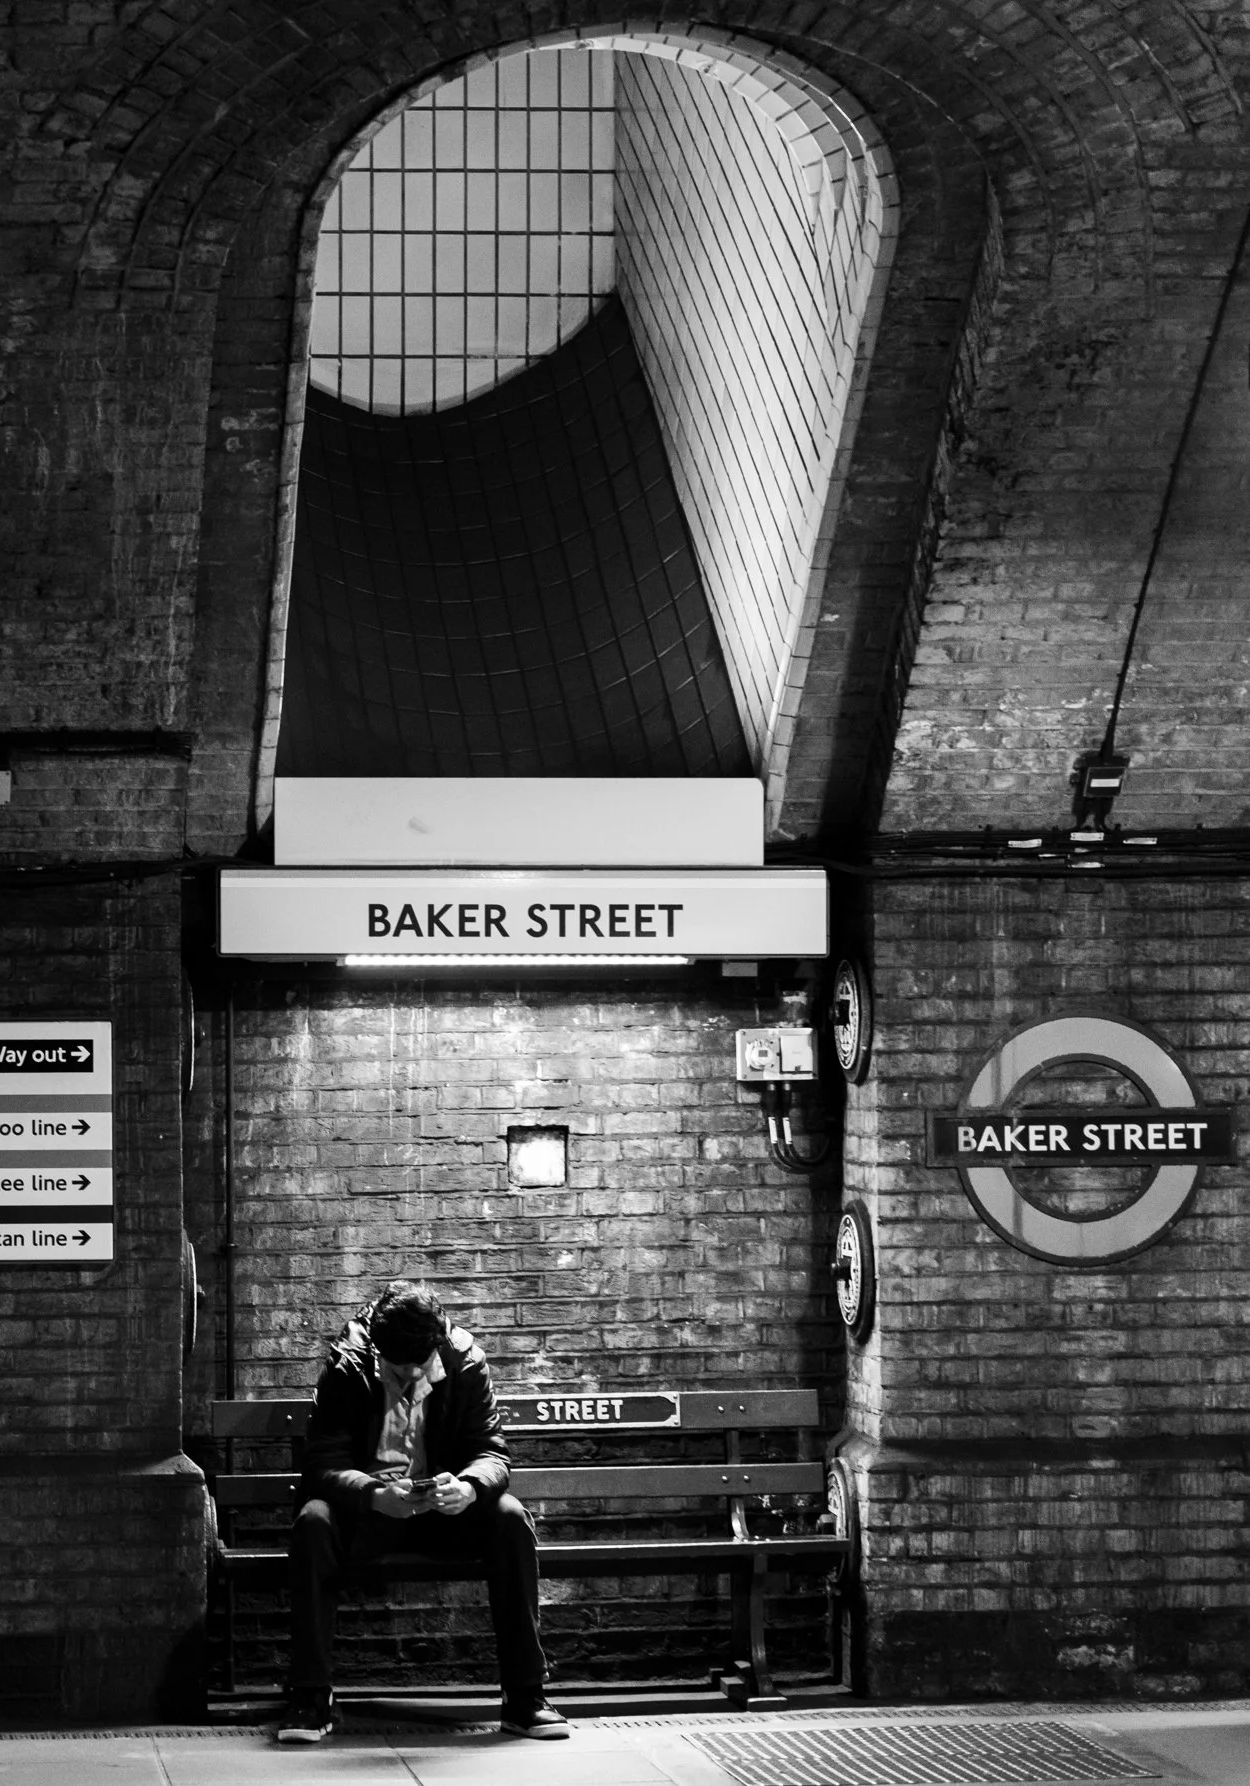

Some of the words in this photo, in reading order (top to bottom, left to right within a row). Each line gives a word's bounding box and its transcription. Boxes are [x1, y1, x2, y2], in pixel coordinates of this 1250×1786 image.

[367, 903, 509, 938] BAKER
[526, 903, 683, 938] STREET
[32, 1047, 67, 1063] out
[32, 1119, 67, 1137] line
[957, 1125, 1071, 1152] BAKER
[1082, 1123, 1208, 1150] STREET
[32, 1174, 67, 1191] line
[32, 1230, 67, 1246] line
[536, 1400, 624, 1423] STREET
